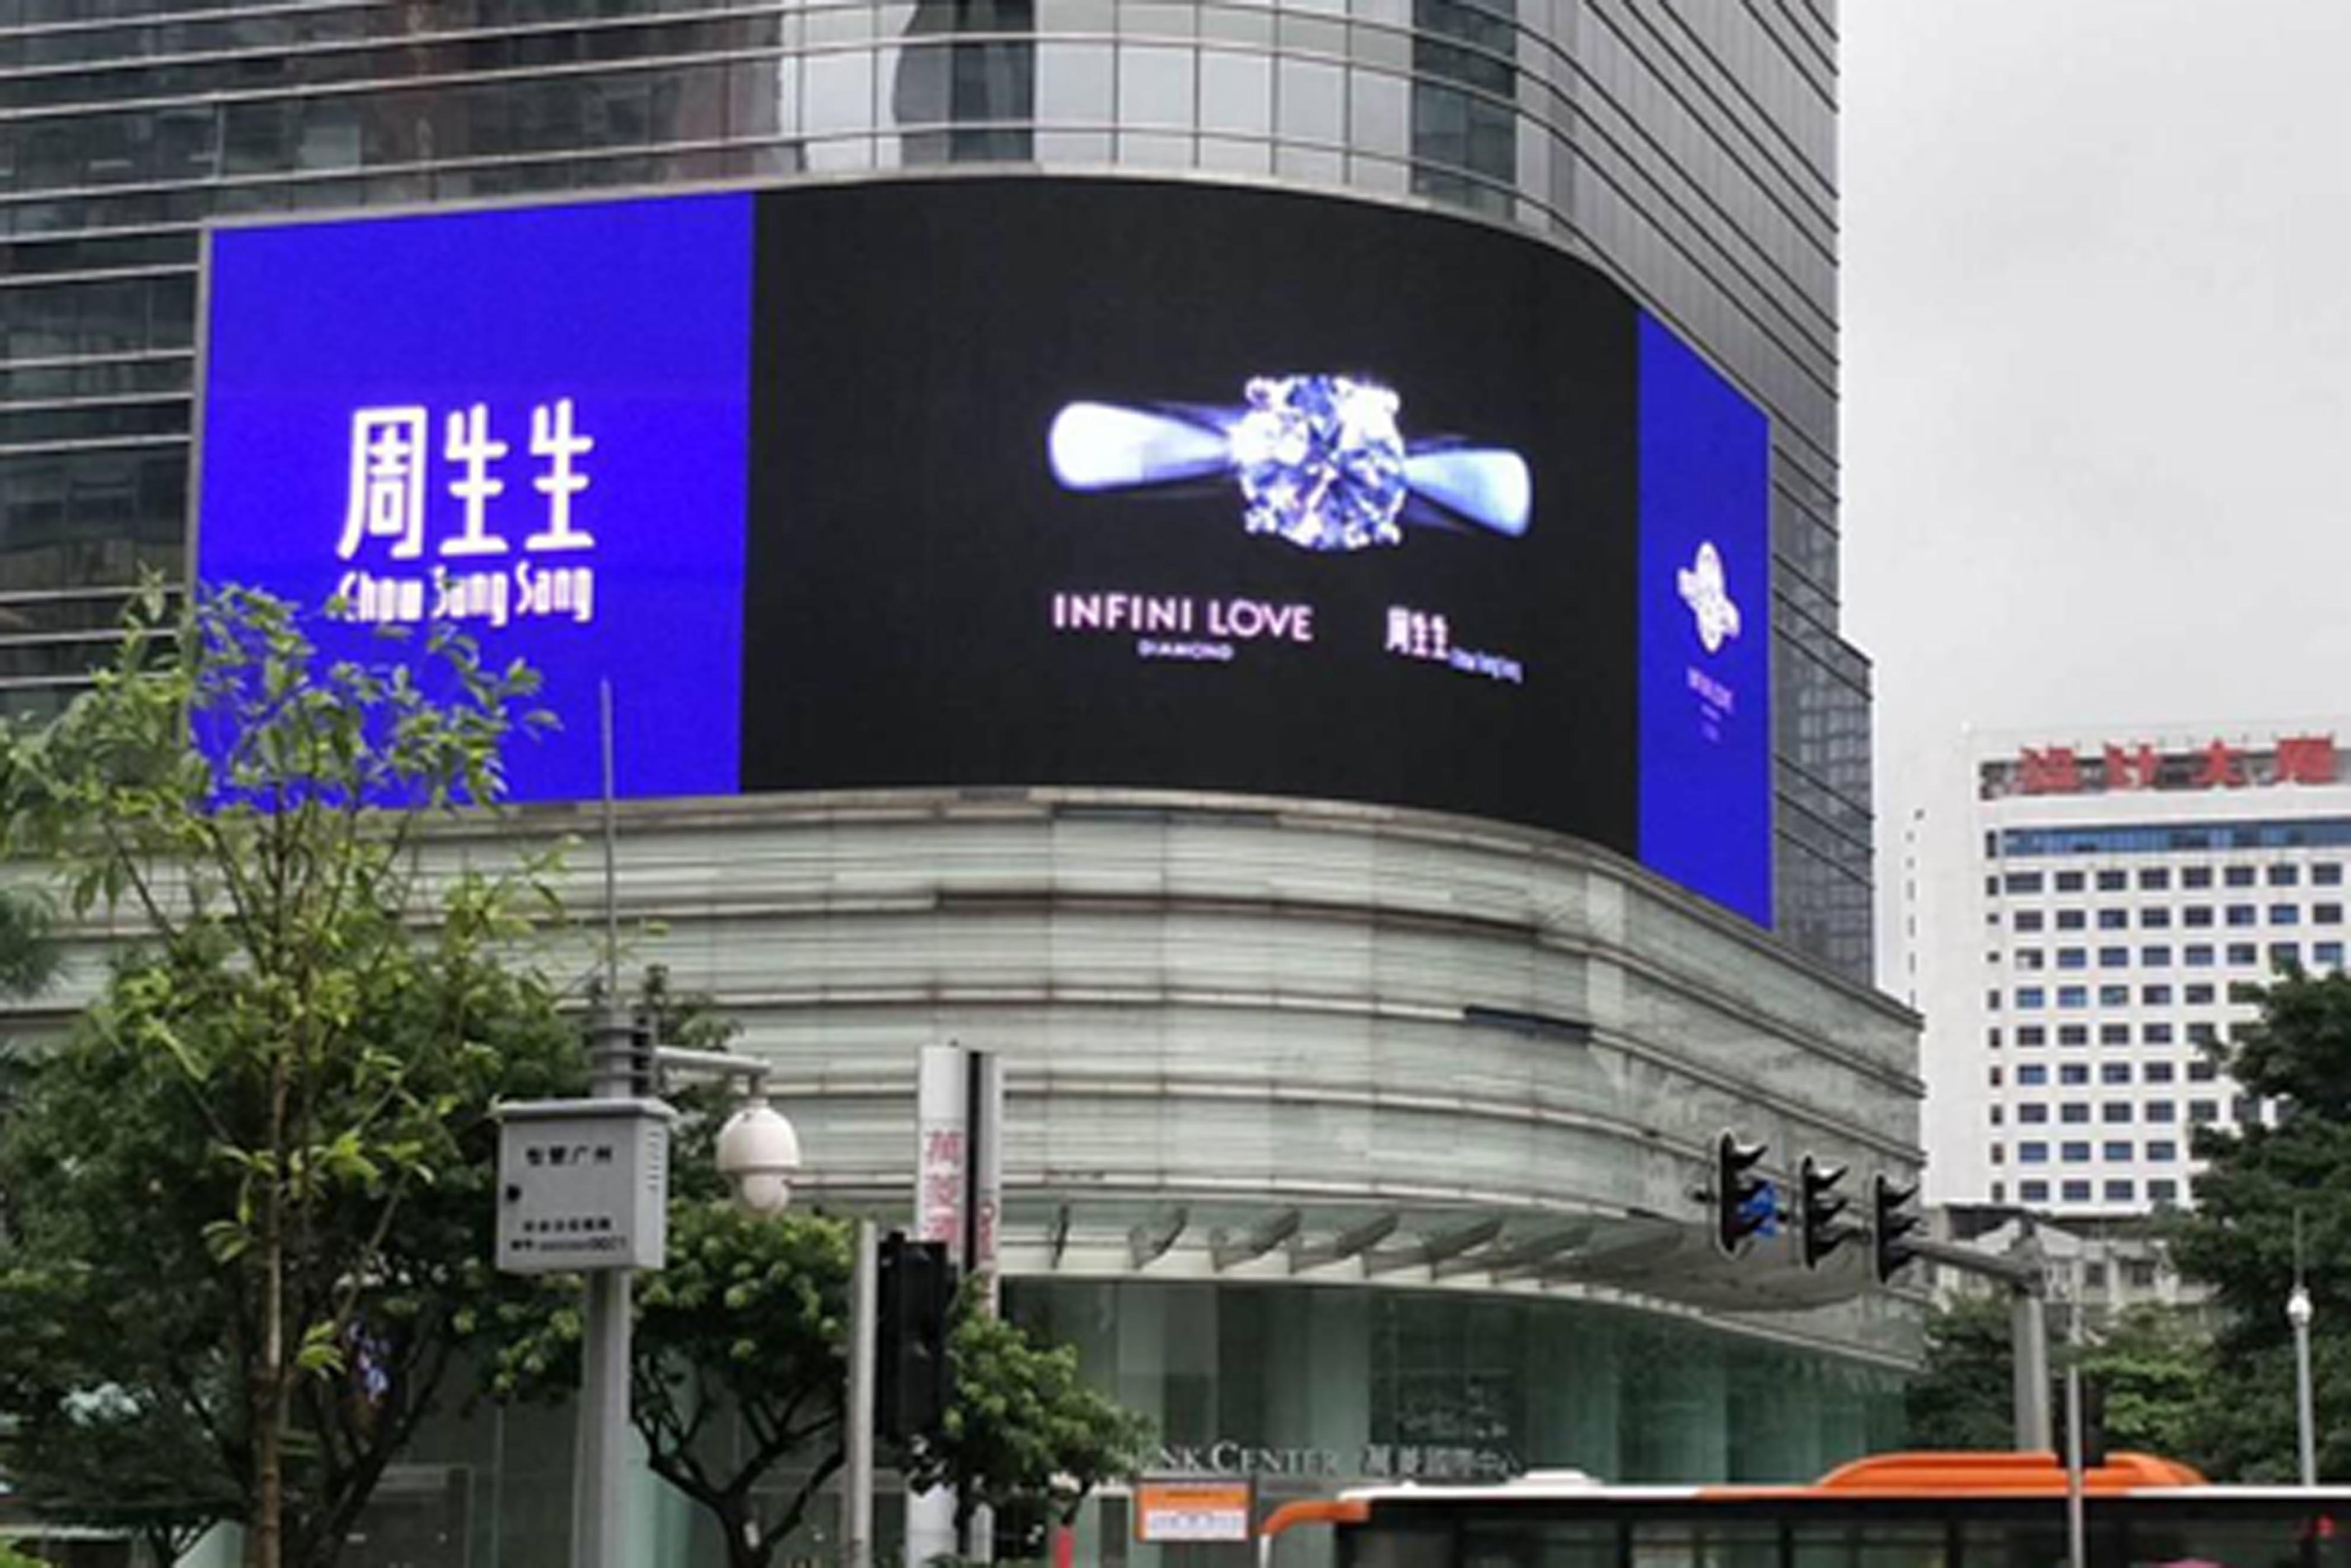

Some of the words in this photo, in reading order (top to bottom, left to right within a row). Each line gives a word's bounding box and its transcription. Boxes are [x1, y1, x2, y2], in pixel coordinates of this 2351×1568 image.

[337, 398, 594, 560] 周生生
[430, 564, 508, 627] Sang
[515, 560, 593, 623] Sang
[1054, 593, 1193, 631] INFINI
[1206, 599, 1314, 641] LOVE
